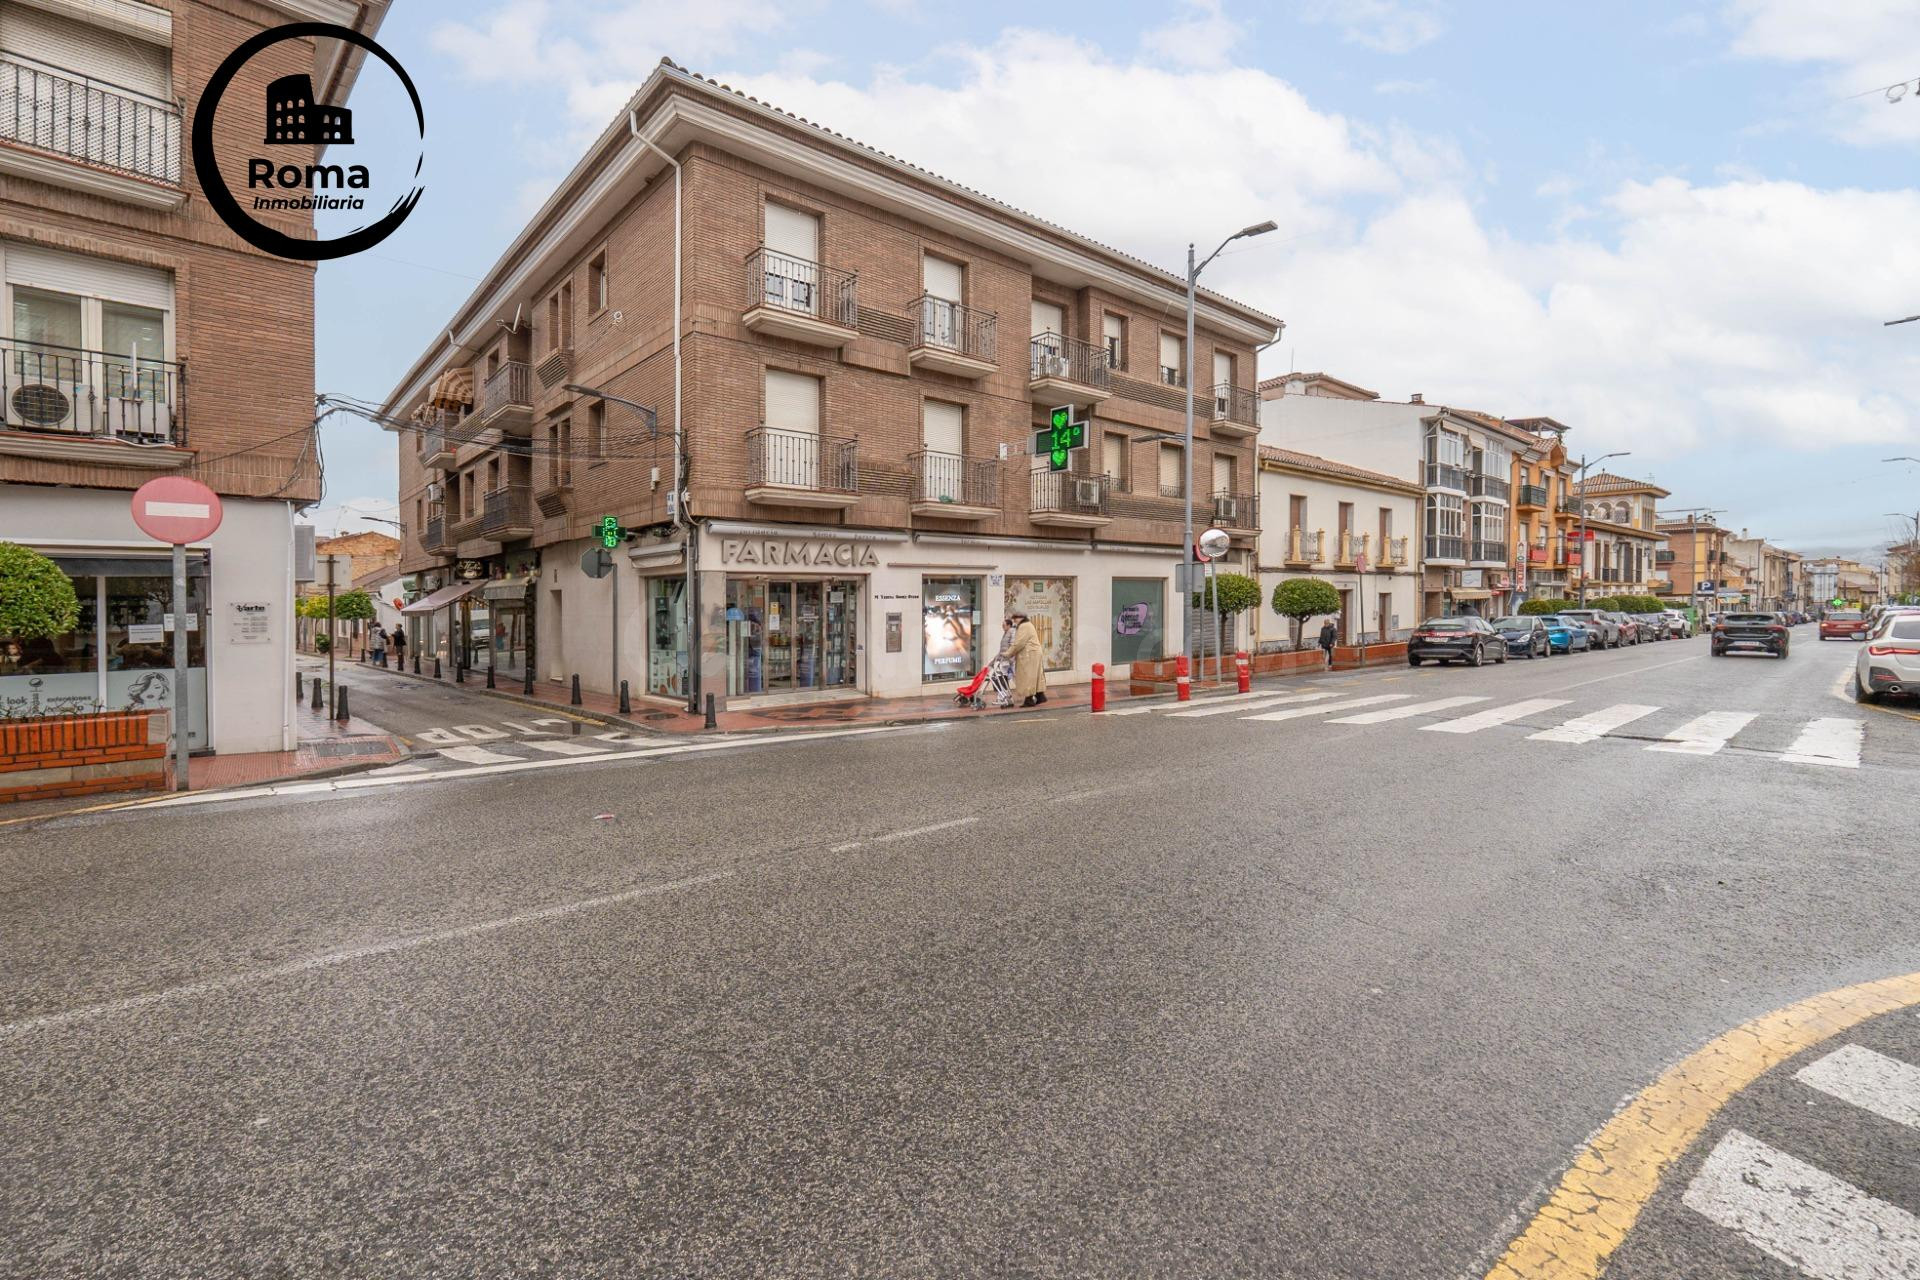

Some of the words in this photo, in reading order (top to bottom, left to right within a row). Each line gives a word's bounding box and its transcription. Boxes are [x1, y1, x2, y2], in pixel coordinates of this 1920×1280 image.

[721, 540, 880, 567] FARMACIA
[935, 594, 961, 602] ESSENZA
[934, 656, 962, 665] PERFUME
[6, 696, 27, 705] look
